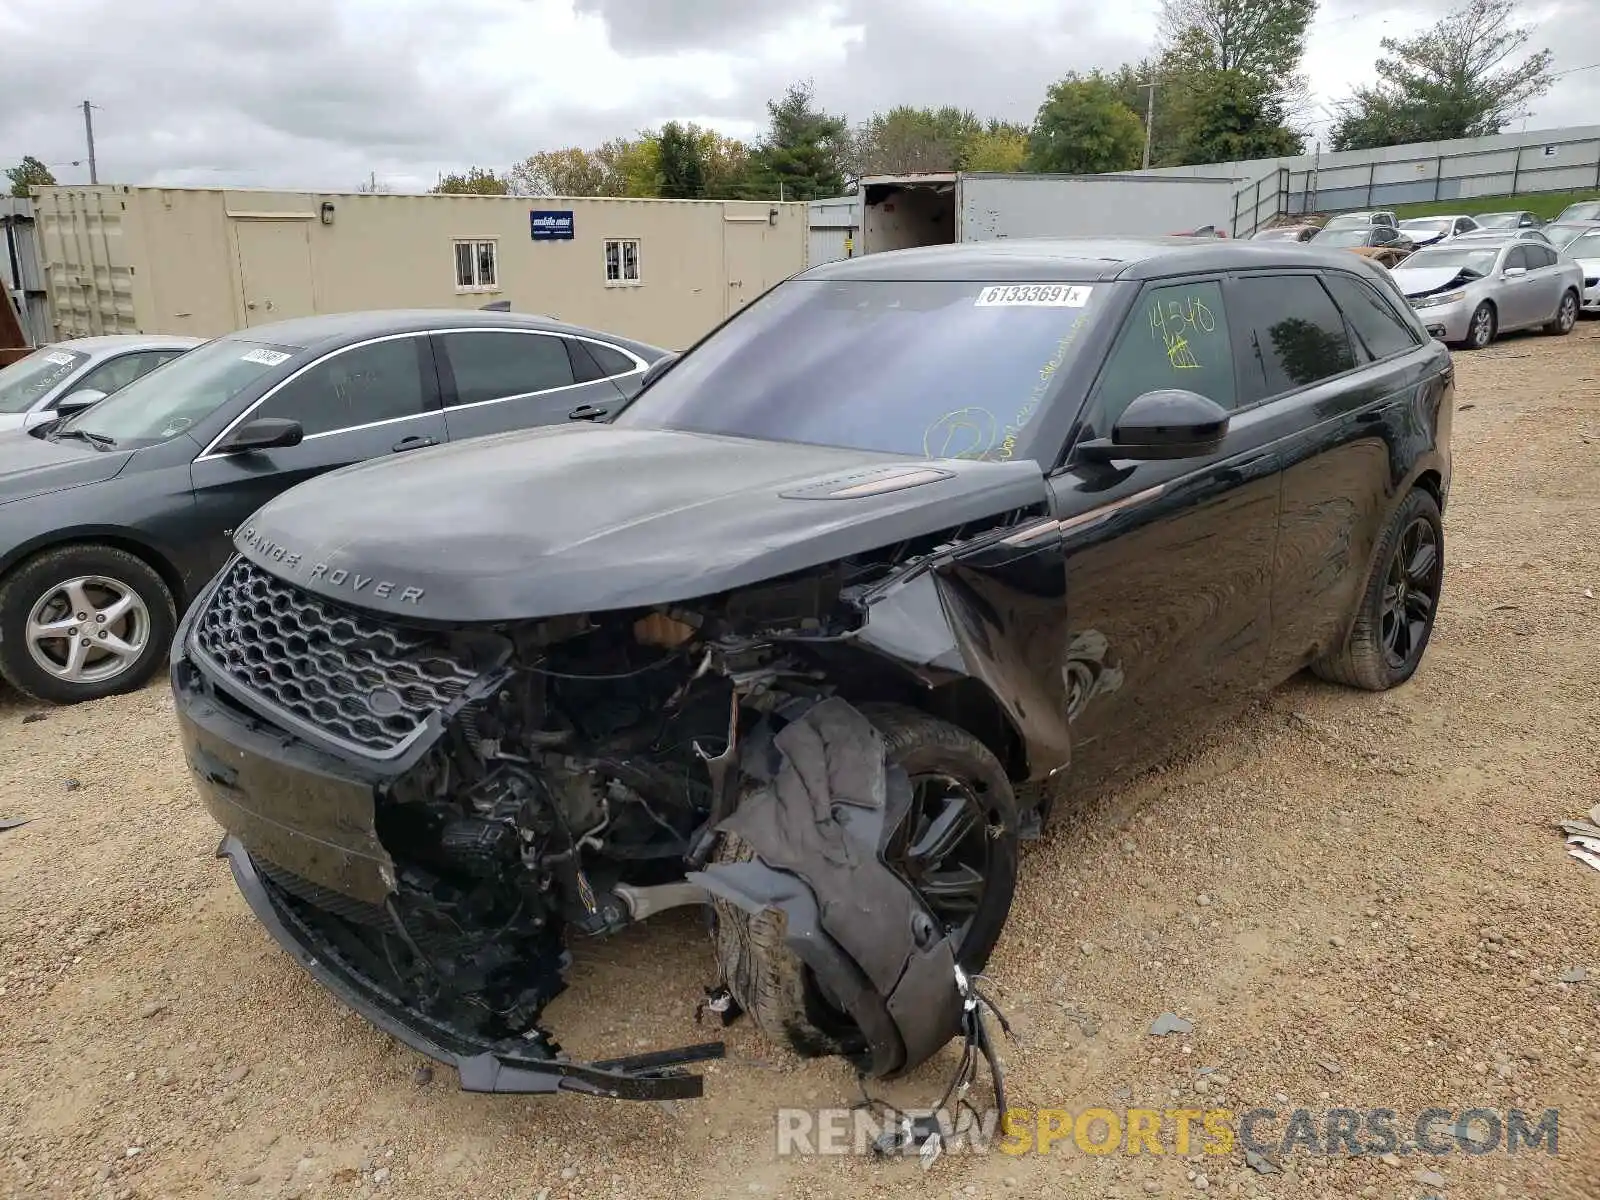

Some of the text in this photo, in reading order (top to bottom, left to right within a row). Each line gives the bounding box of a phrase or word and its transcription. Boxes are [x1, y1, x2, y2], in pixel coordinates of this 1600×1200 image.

[1544, 146, 1556, 156] E
[533, 216, 555, 226] mobile
[243, 527, 425, 604] RANGE ROVER
